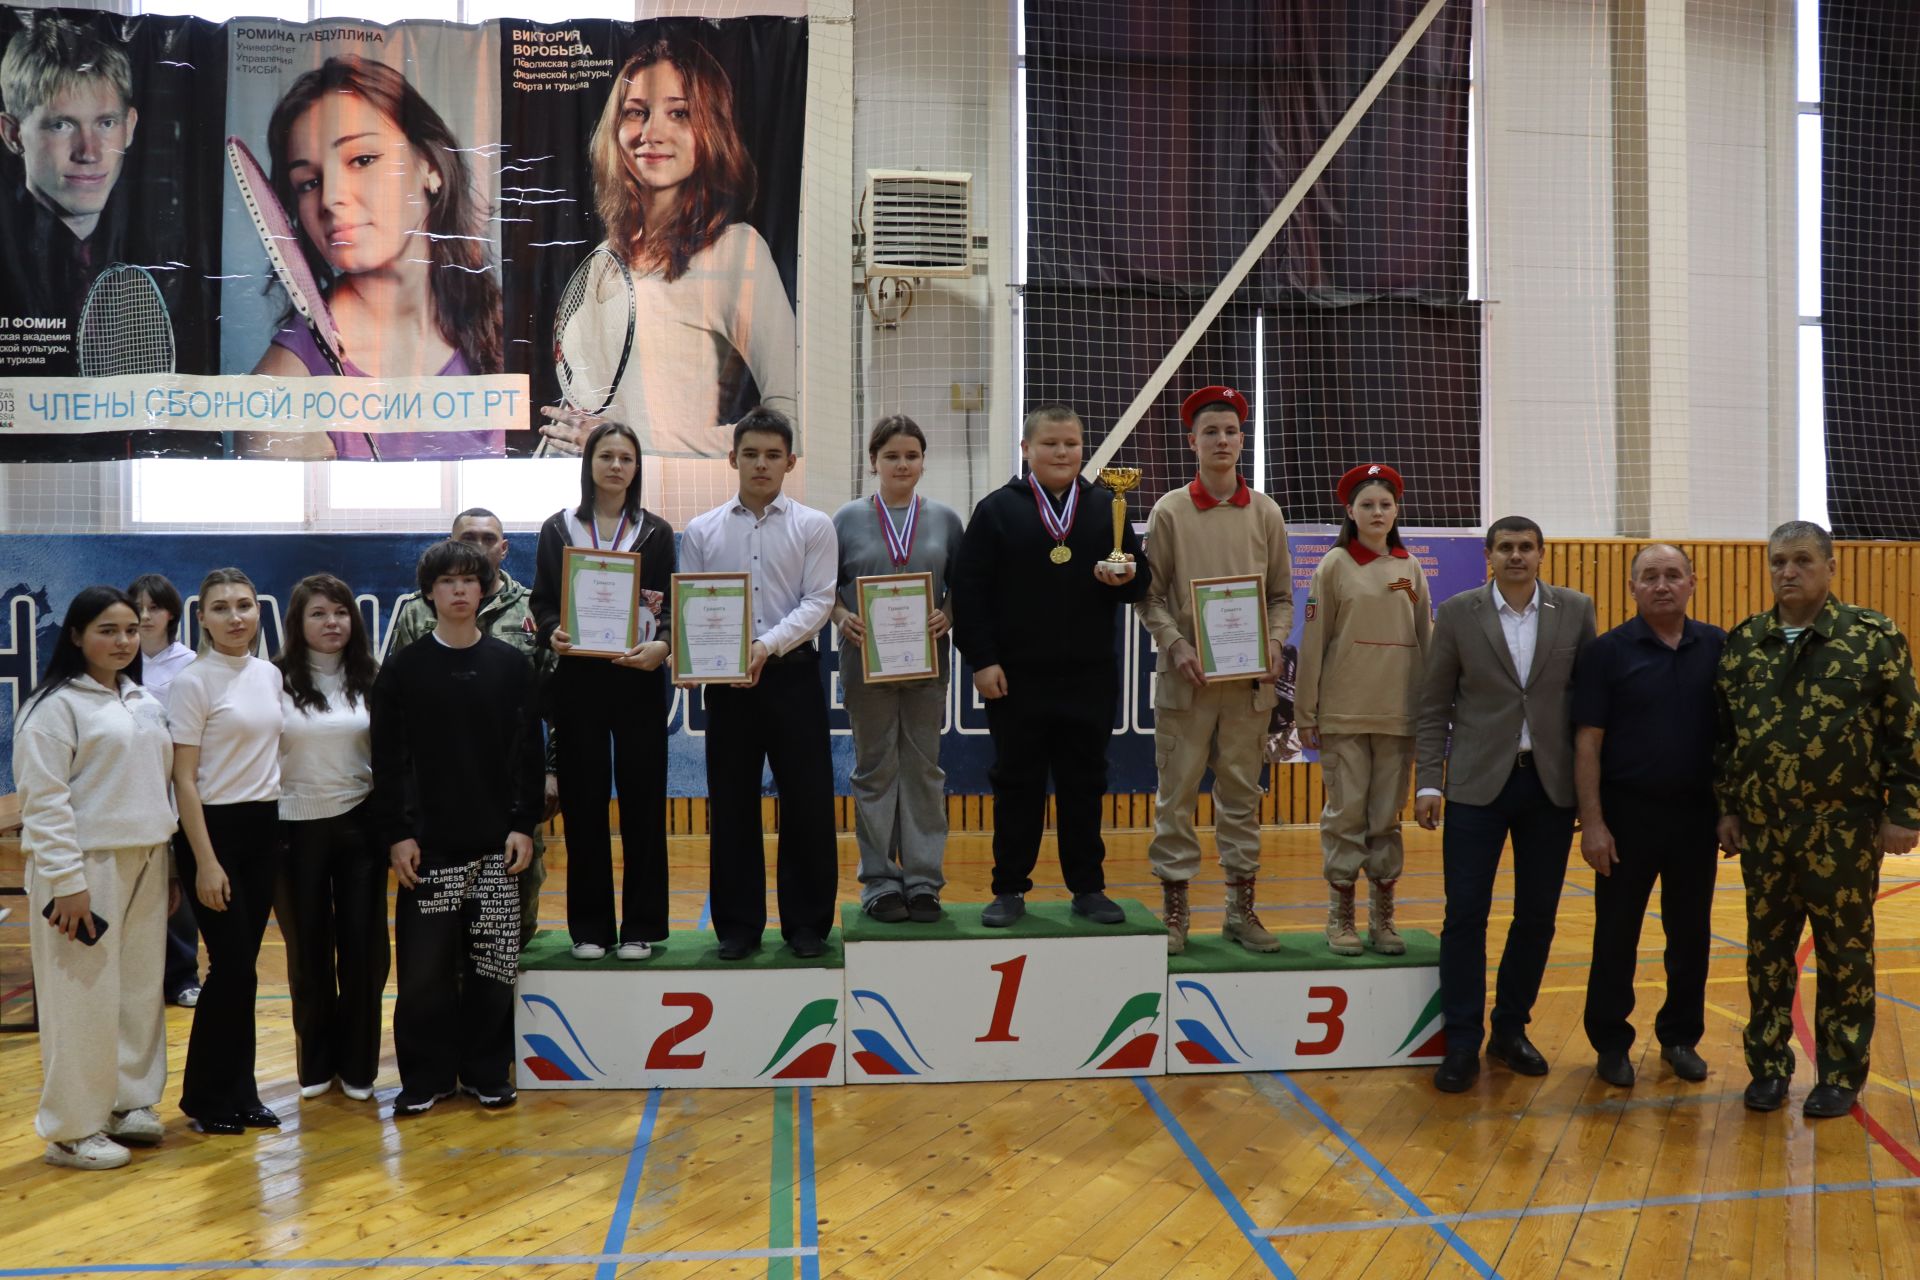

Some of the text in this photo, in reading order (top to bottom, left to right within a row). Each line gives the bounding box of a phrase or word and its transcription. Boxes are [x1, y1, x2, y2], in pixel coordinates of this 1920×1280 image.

[237, 28, 383, 43] РОМИНА ГАБДУЛЛИНА
[512, 29, 581, 42] ВИКТОРИЯ
[236, 42, 296, 54] Университет
[513, 44, 593, 57] ВОРОБЬЕВА
[236, 53, 293, 65] Управления
[513, 81, 543, 92] спорта
[12, 317, 67, 329] ФОМИН
[22, 333, 71, 342] академия
[22, 345, 70, 354] культуры,
[7, 357, 46, 366] туризма
[29, 386, 521, 421] ЧЛЕНЫ СБОРНОЙ РОССИИ ОТ РТ
[417, 898, 450, 907] TENDER
[420, 905, 449, 914] WITHIN
[483, 928, 501, 936] AND
[473, 942, 505, 952] GENTLE
[495, 937, 506, 945] US
[975, 954, 1027, 1043] 1
[1294, 986, 1349, 1056] 3
[645, 992, 714, 1070] 2
